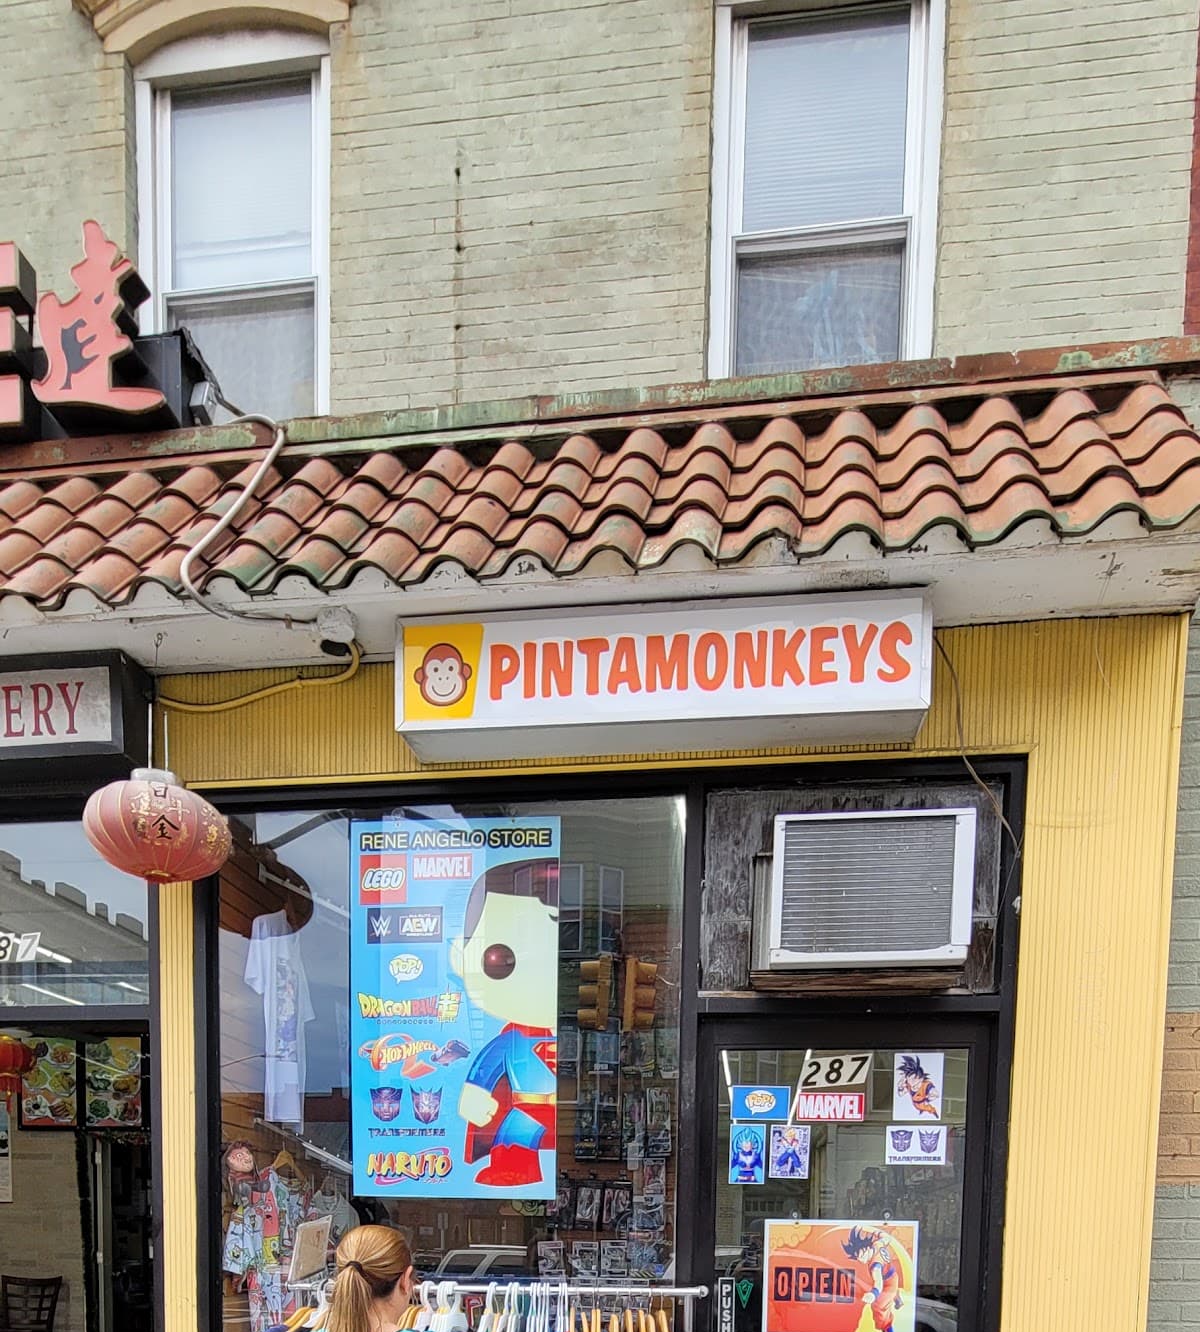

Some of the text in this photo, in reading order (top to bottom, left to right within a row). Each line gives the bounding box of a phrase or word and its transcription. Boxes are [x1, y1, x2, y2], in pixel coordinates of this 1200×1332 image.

[488, 621, 913, 700] PINTAMONKEYS
[1, 680, 85, 738] ERY
[361, 829, 552, 850] RENE ANGELO STORE
[362, 868, 405, 890] LEGO
[413, 856, 471, 878] MARVEL
[401, 917, 438, 933] AEW
[801, 1055, 869, 1088] 287
[747, 1093, 776, 1109] POP!
[799, 1095, 862, 1119] MARVEL
[367, 1151, 453, 1180] NARUTO
[777, 1270, 854, 1299] OPEN
